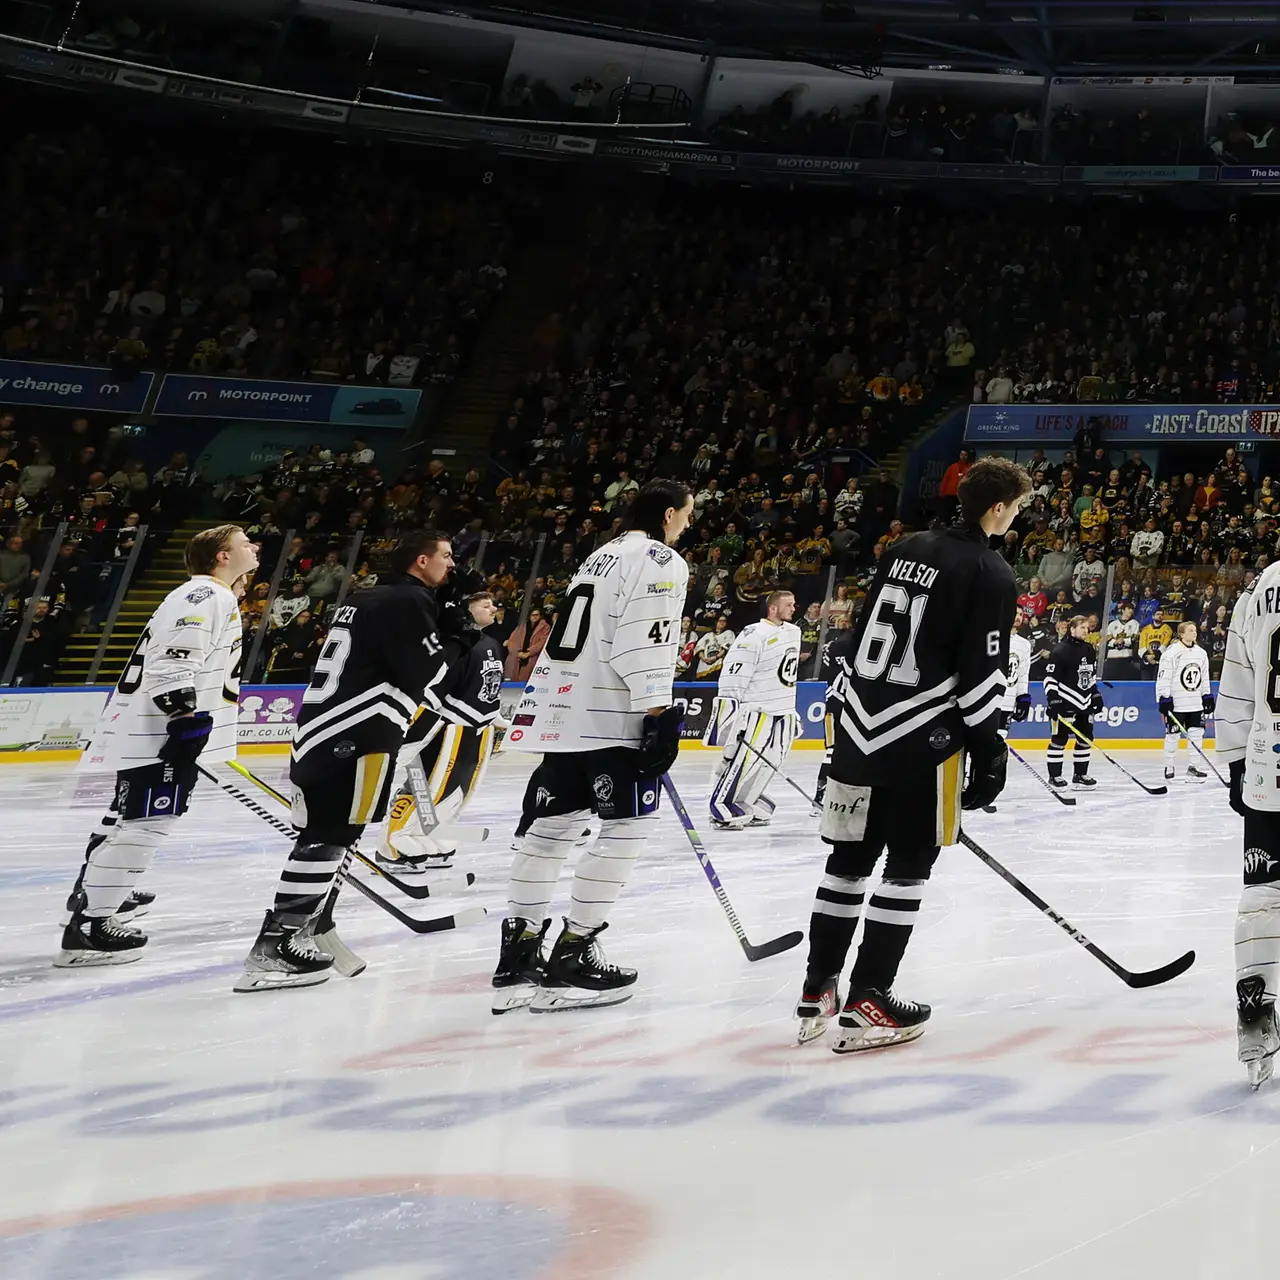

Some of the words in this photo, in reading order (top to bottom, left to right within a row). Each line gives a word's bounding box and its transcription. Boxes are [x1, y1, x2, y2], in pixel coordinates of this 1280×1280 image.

[777, 158, 860, 170] MOTORPOINT
[1251, 169, 1267, 177] The
[482, 171, 493, 185] 8
[12, 377, 83, 395] change
[219, 389, 312, 404] MOTORPOINT
[1035, 415, 1074, 431] LIFE'S
[1151, 413, 1187, 434] EAST
[1195, 409, 1249, 434] Coast
[648, 621, 670, 643] 47
[854, 584, 929, 686] 61
[728, 663, 743, 674] 47
[784, 658, 798, 676] 47
[1185, 670, 1199, 683] 47
[829, 797, 865, 815] mf
[716, 887, 746, 940] WARRIOR
[1044, 907, 1092, 947] CCM
[860, 1001, 895, 1028] CCM
